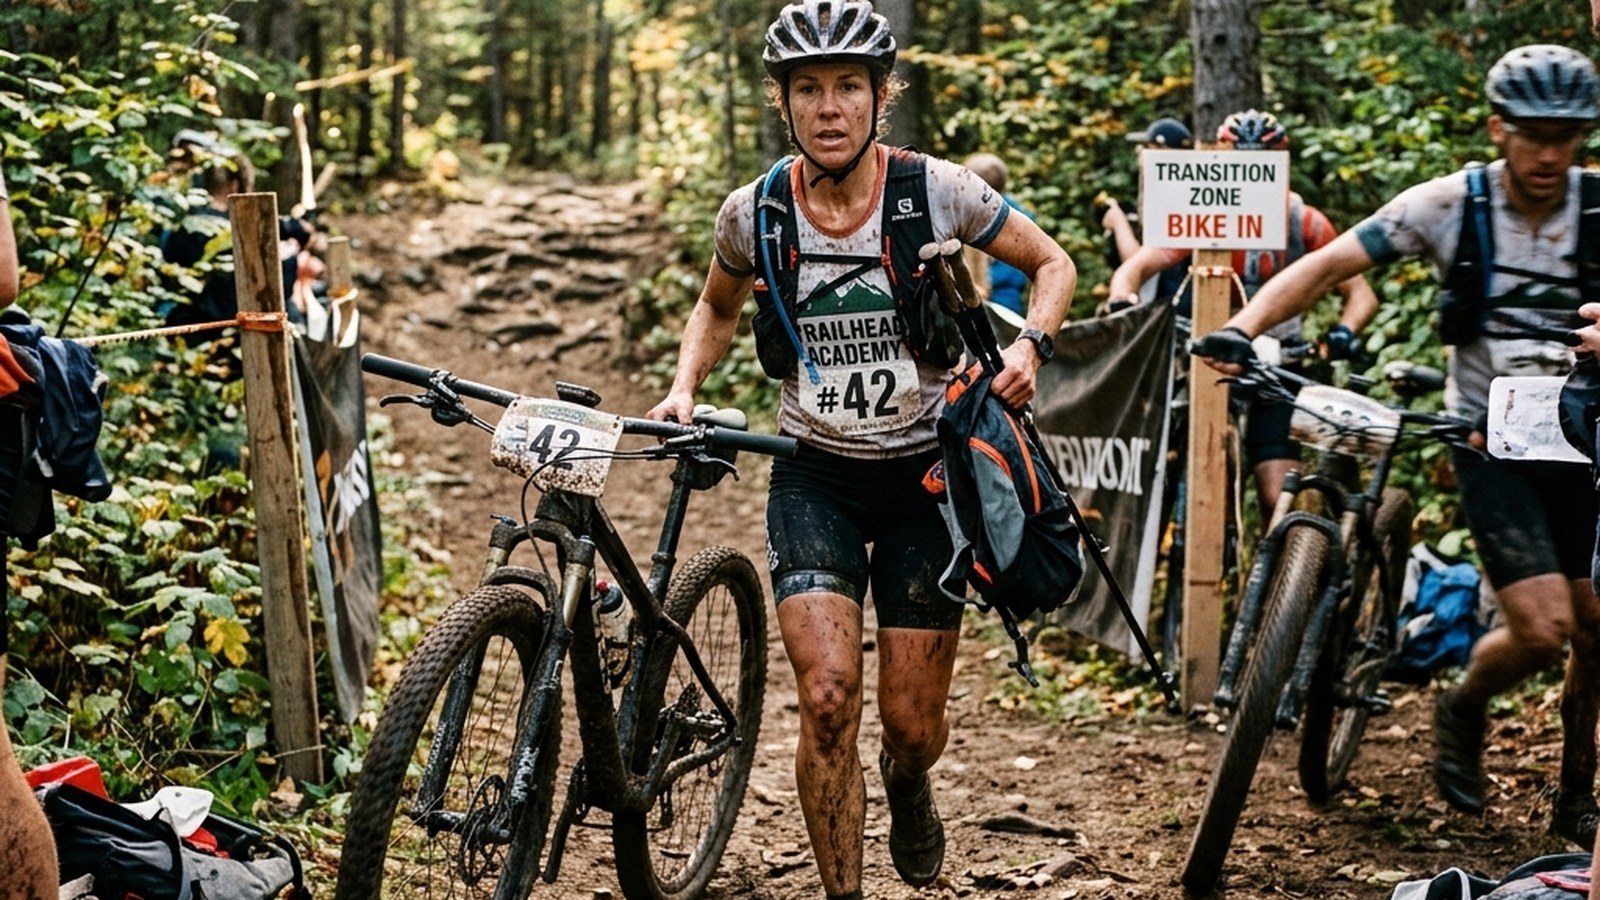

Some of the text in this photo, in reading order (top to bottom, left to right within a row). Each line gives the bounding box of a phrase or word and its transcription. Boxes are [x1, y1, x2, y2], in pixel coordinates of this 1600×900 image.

[1156, 163, 1275, 182] TRANSITION
[1189, 187, 1241, 206] ZONE
[1168, 214, 1262, 238] BIKE IN
[807, 340, 901, 367] ACADEMY
[817, 368, 899, 419] #42
[529, 424, 581, 471] 42
